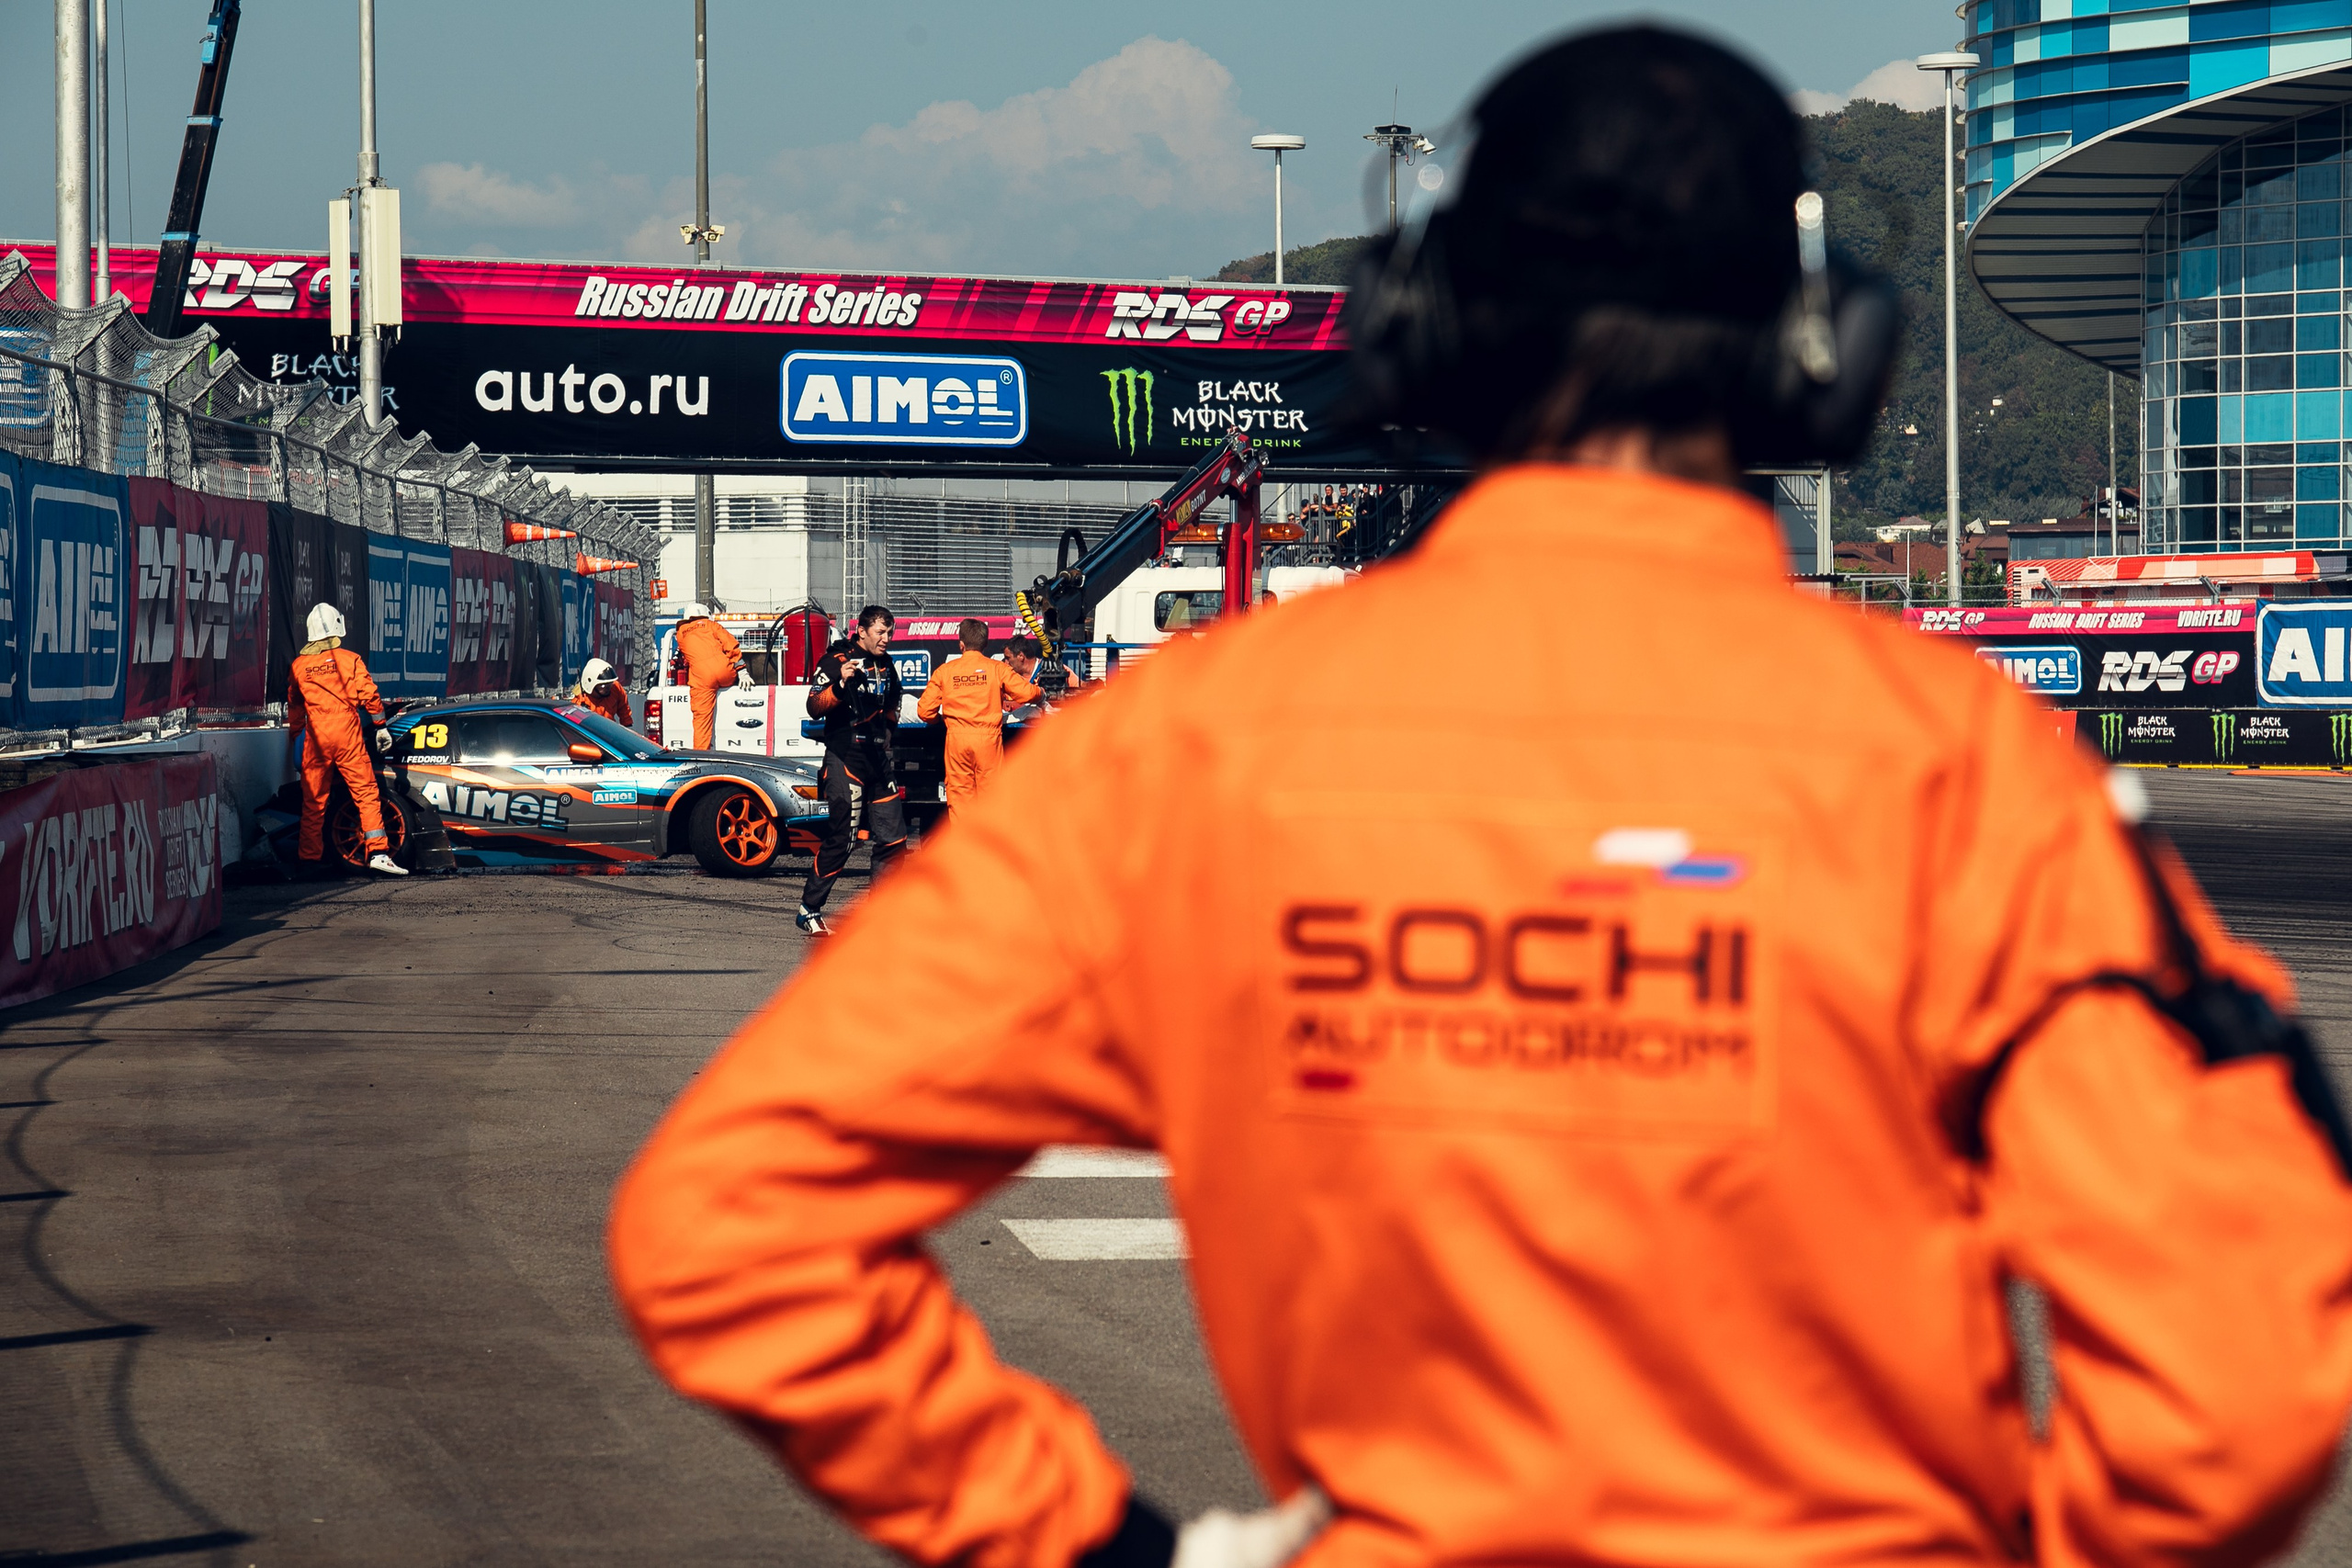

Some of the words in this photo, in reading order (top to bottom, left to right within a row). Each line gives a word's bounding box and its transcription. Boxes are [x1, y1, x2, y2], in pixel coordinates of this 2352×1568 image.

[574, 276, 726, 321] Russian
[724, 281, 808, 323] Drift
[807, 284, 922, 326] Series
[1105, 292, 1236, 341] RDS
[1232, 299, 1293, 336] GP
[475, 364, 709, 415] auto.ru
[1198, 379, 1283, 404] BLACK
[1181, 437, 1223, 446] ENER
[1253, 439, 1302, 447] DRINK
[1918, 610, 1966, 631] RDS
[1963, 612, 1985, 626] GP
[2028, 613, 2075, 629] RUSSIAN
[2075, 613, 2109, 629] DRIFT
[2107, 613, 2145, 628] SERIES
[2177, 609, 2243, 627] VDRIFTE.RU
[908, 622, 942, 636] RUSSIAN
[2267, 627, 2352, 682] AI
[953, 674, 988, 683] SOCHI
[2098, 650, 2194, 692] RDS
[2192, 650, 2240, 685] GP
[668, 695, 689, 704] FIRE
[2137, 716, 2167, 727] BLACK
[2250, 716, 2282, 728] BLACK
[410, 723, 449, 750] 13
[2128, 725, 2177, 738] MONSTER
[2240, 726, 2290, 739] MONSTER
[594, 792, 635, 803] AIMOL
[1283, 900, 1748, 1007] SOCHI
